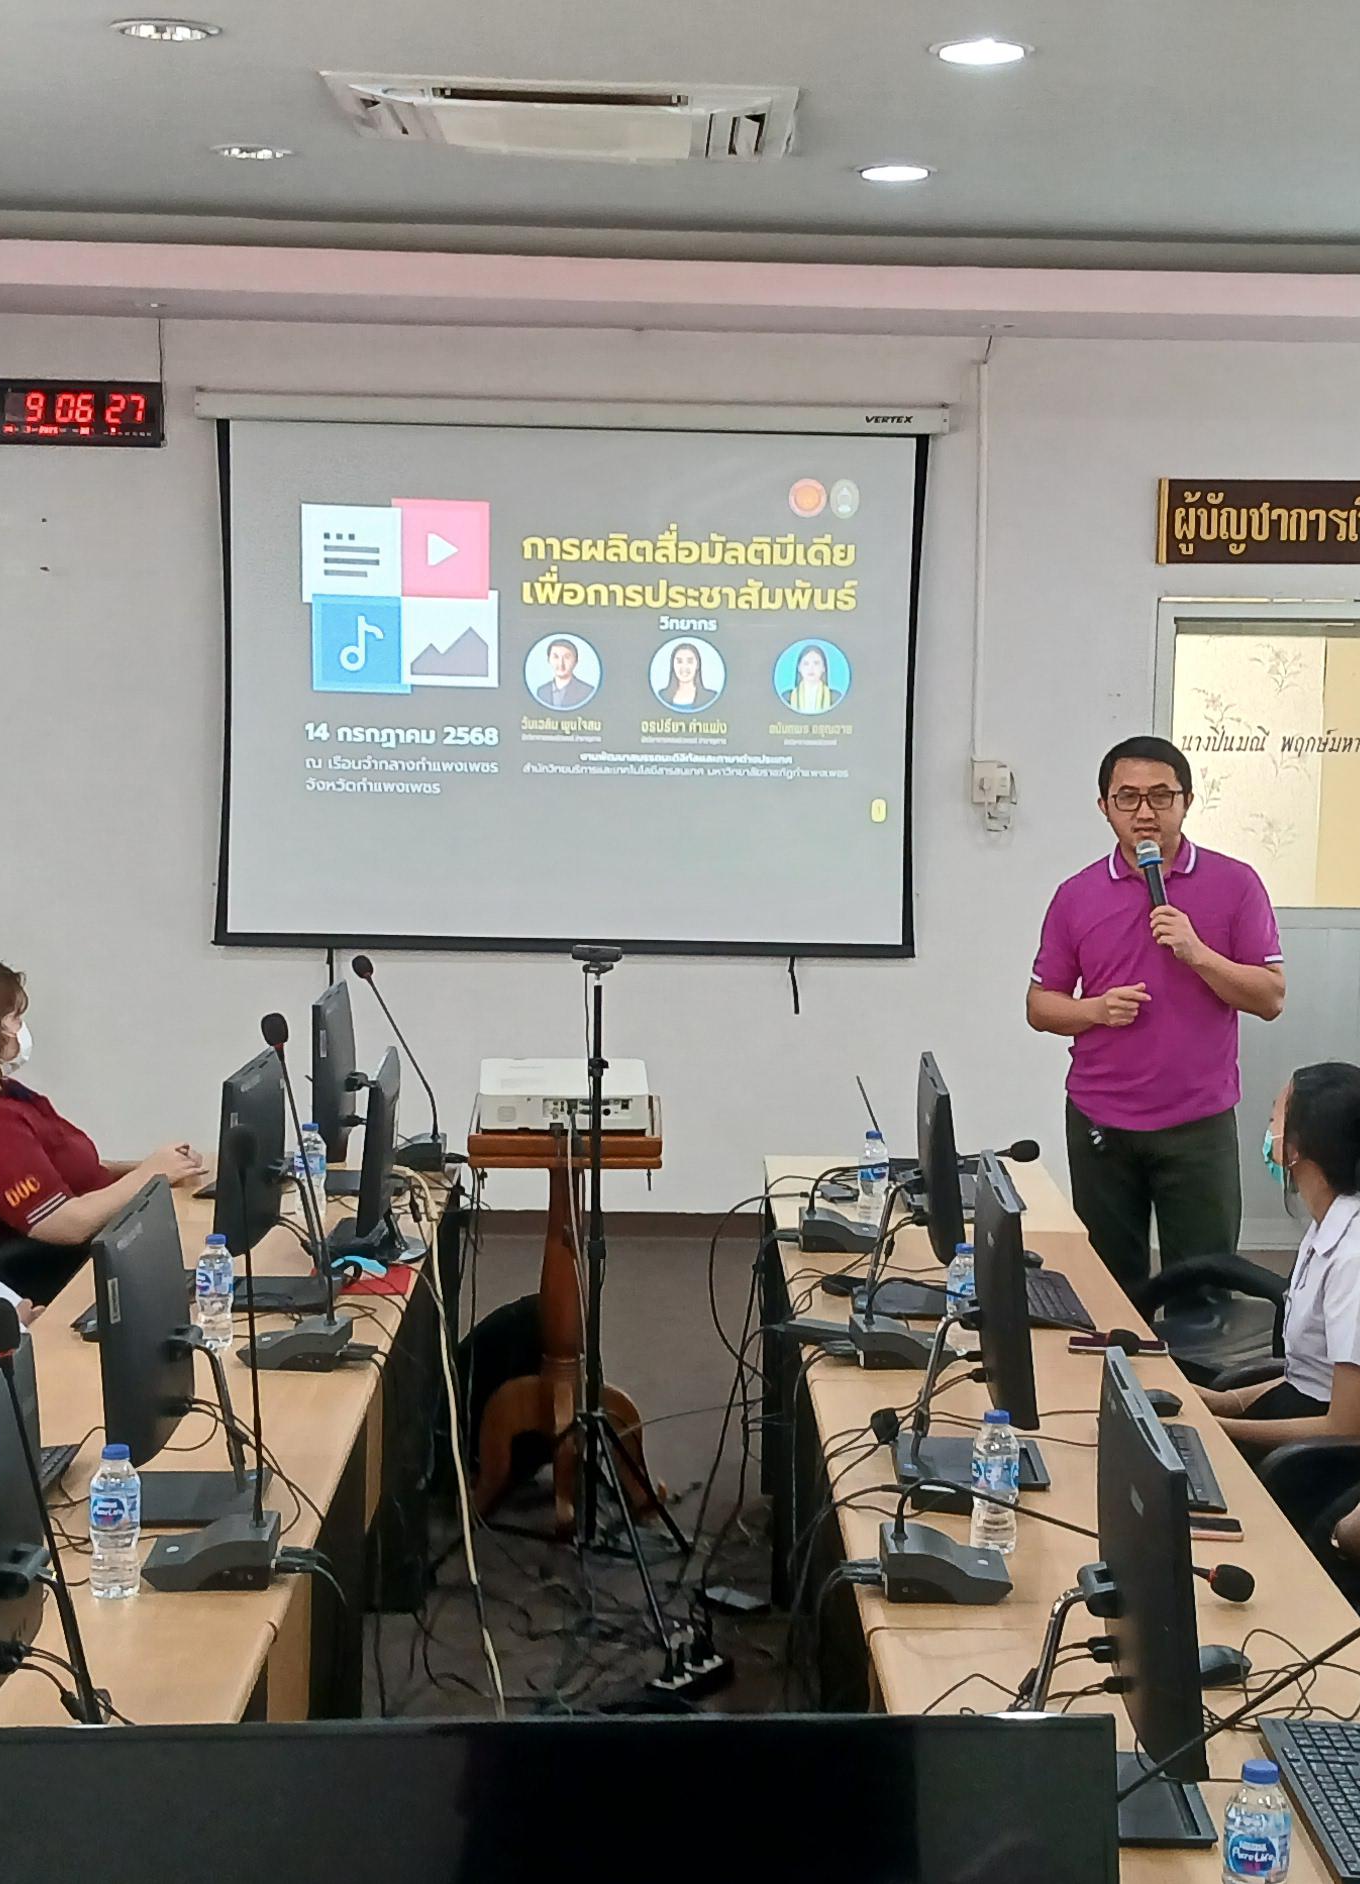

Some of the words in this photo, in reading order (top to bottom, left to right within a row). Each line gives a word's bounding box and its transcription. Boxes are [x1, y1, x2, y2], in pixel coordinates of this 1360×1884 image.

[26, 391, 45, 422] 9
[55, 393, 94, 423] 06
[105, 394, 146, 425] 27
[865, 415, 913, 424] VERTEX
[521, 522, 856, 568] การผลิตสื่อมัลติมีเดีย
[521, 565, 859, 612] เพื่อการประชาสัมพันธ์
[658, 615, 718, 632] วิทยากร
[304, 722, 330, 741] 14
[336, 725, 436, 748] กรกฎาคม
[442, 726, 500, 746] 2568
[1181, 725, 1270, 753] นางปิ่นมณี
[305, 757, 323, 769] ณ
[328, 754, 499, 774] เรือนจำกลางกำแพงเพชร
[306, 777, 441, 795] จังหวัดกำแพงเพชร
